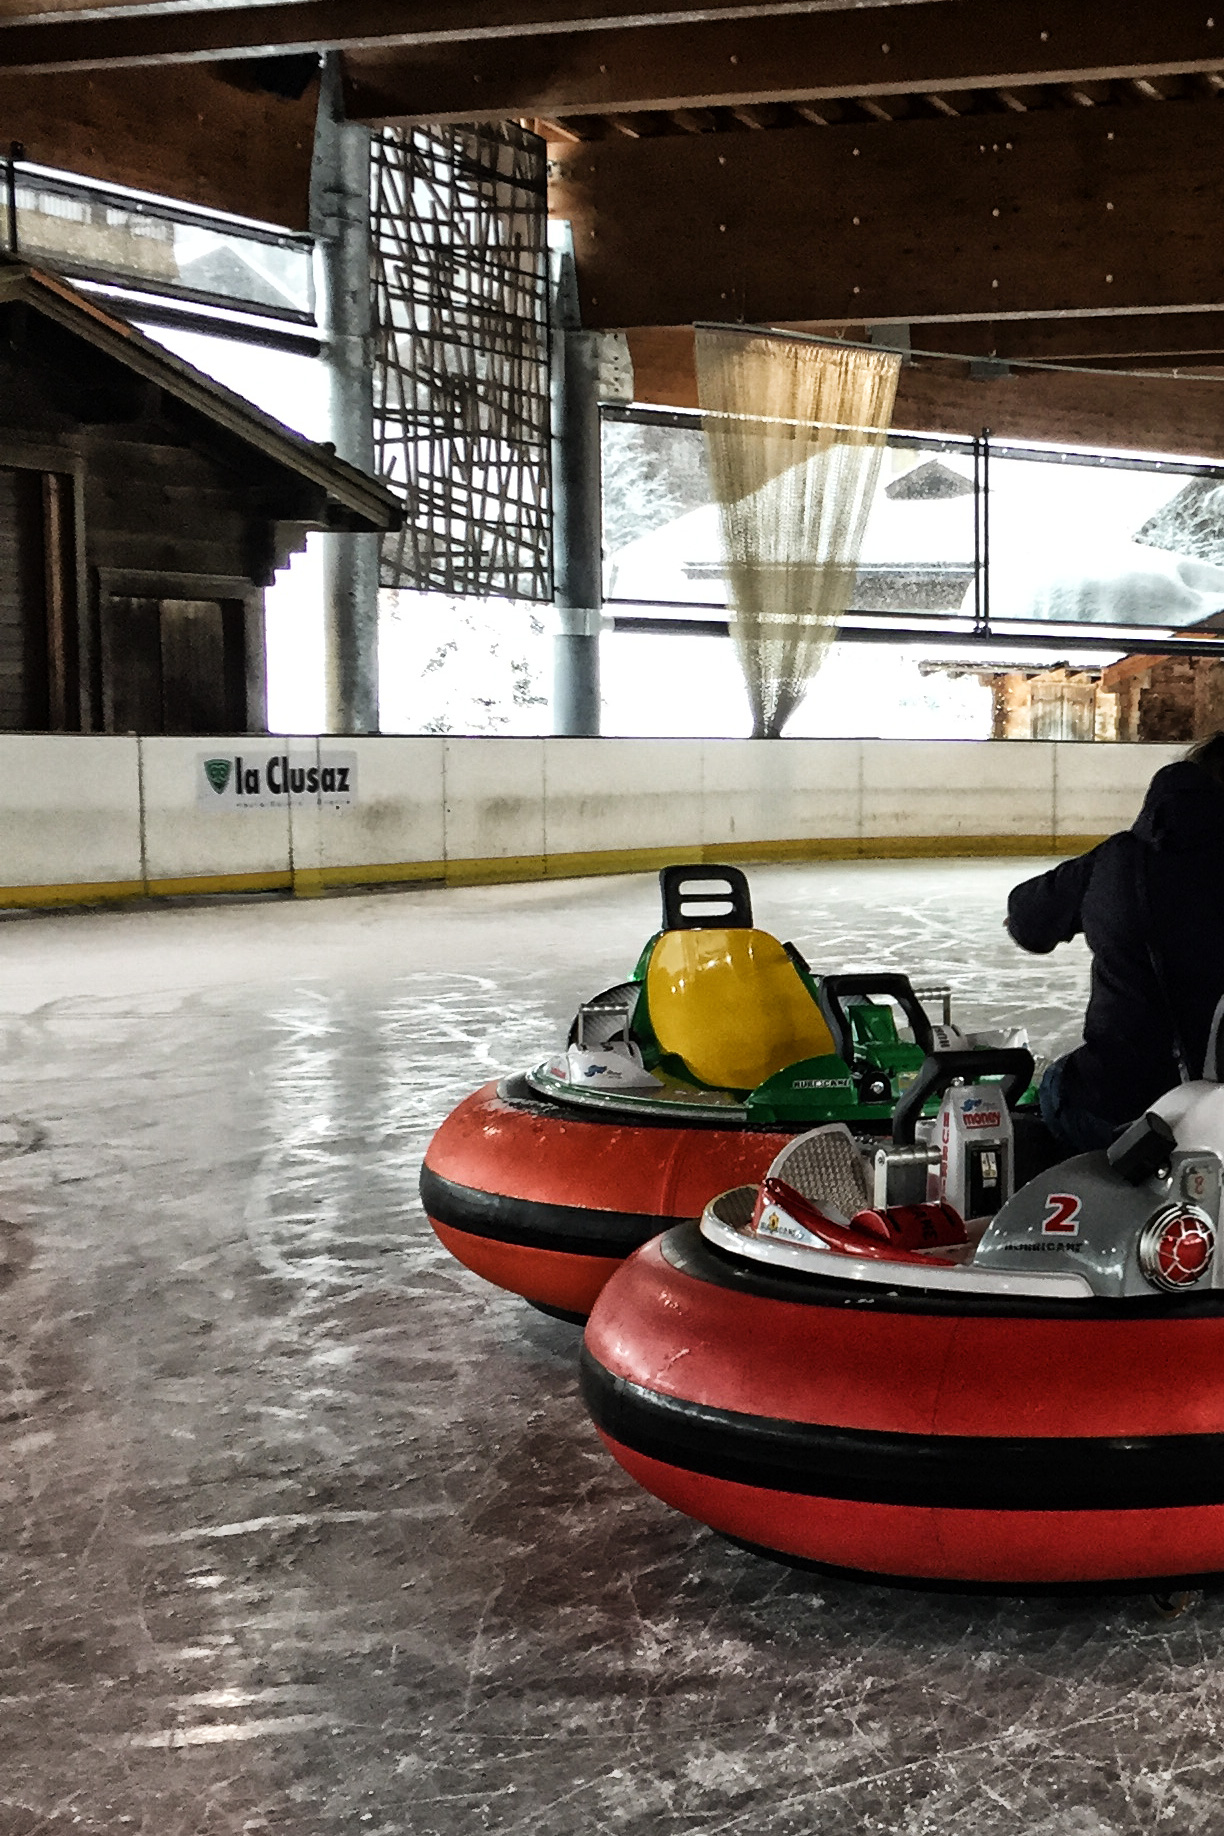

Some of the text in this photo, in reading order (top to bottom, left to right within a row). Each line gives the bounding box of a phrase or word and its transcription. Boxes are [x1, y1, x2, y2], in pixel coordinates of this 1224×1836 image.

[234, 755, 350, 795] la Clusaz
[1041, 1193, 1082, 1237] 2
